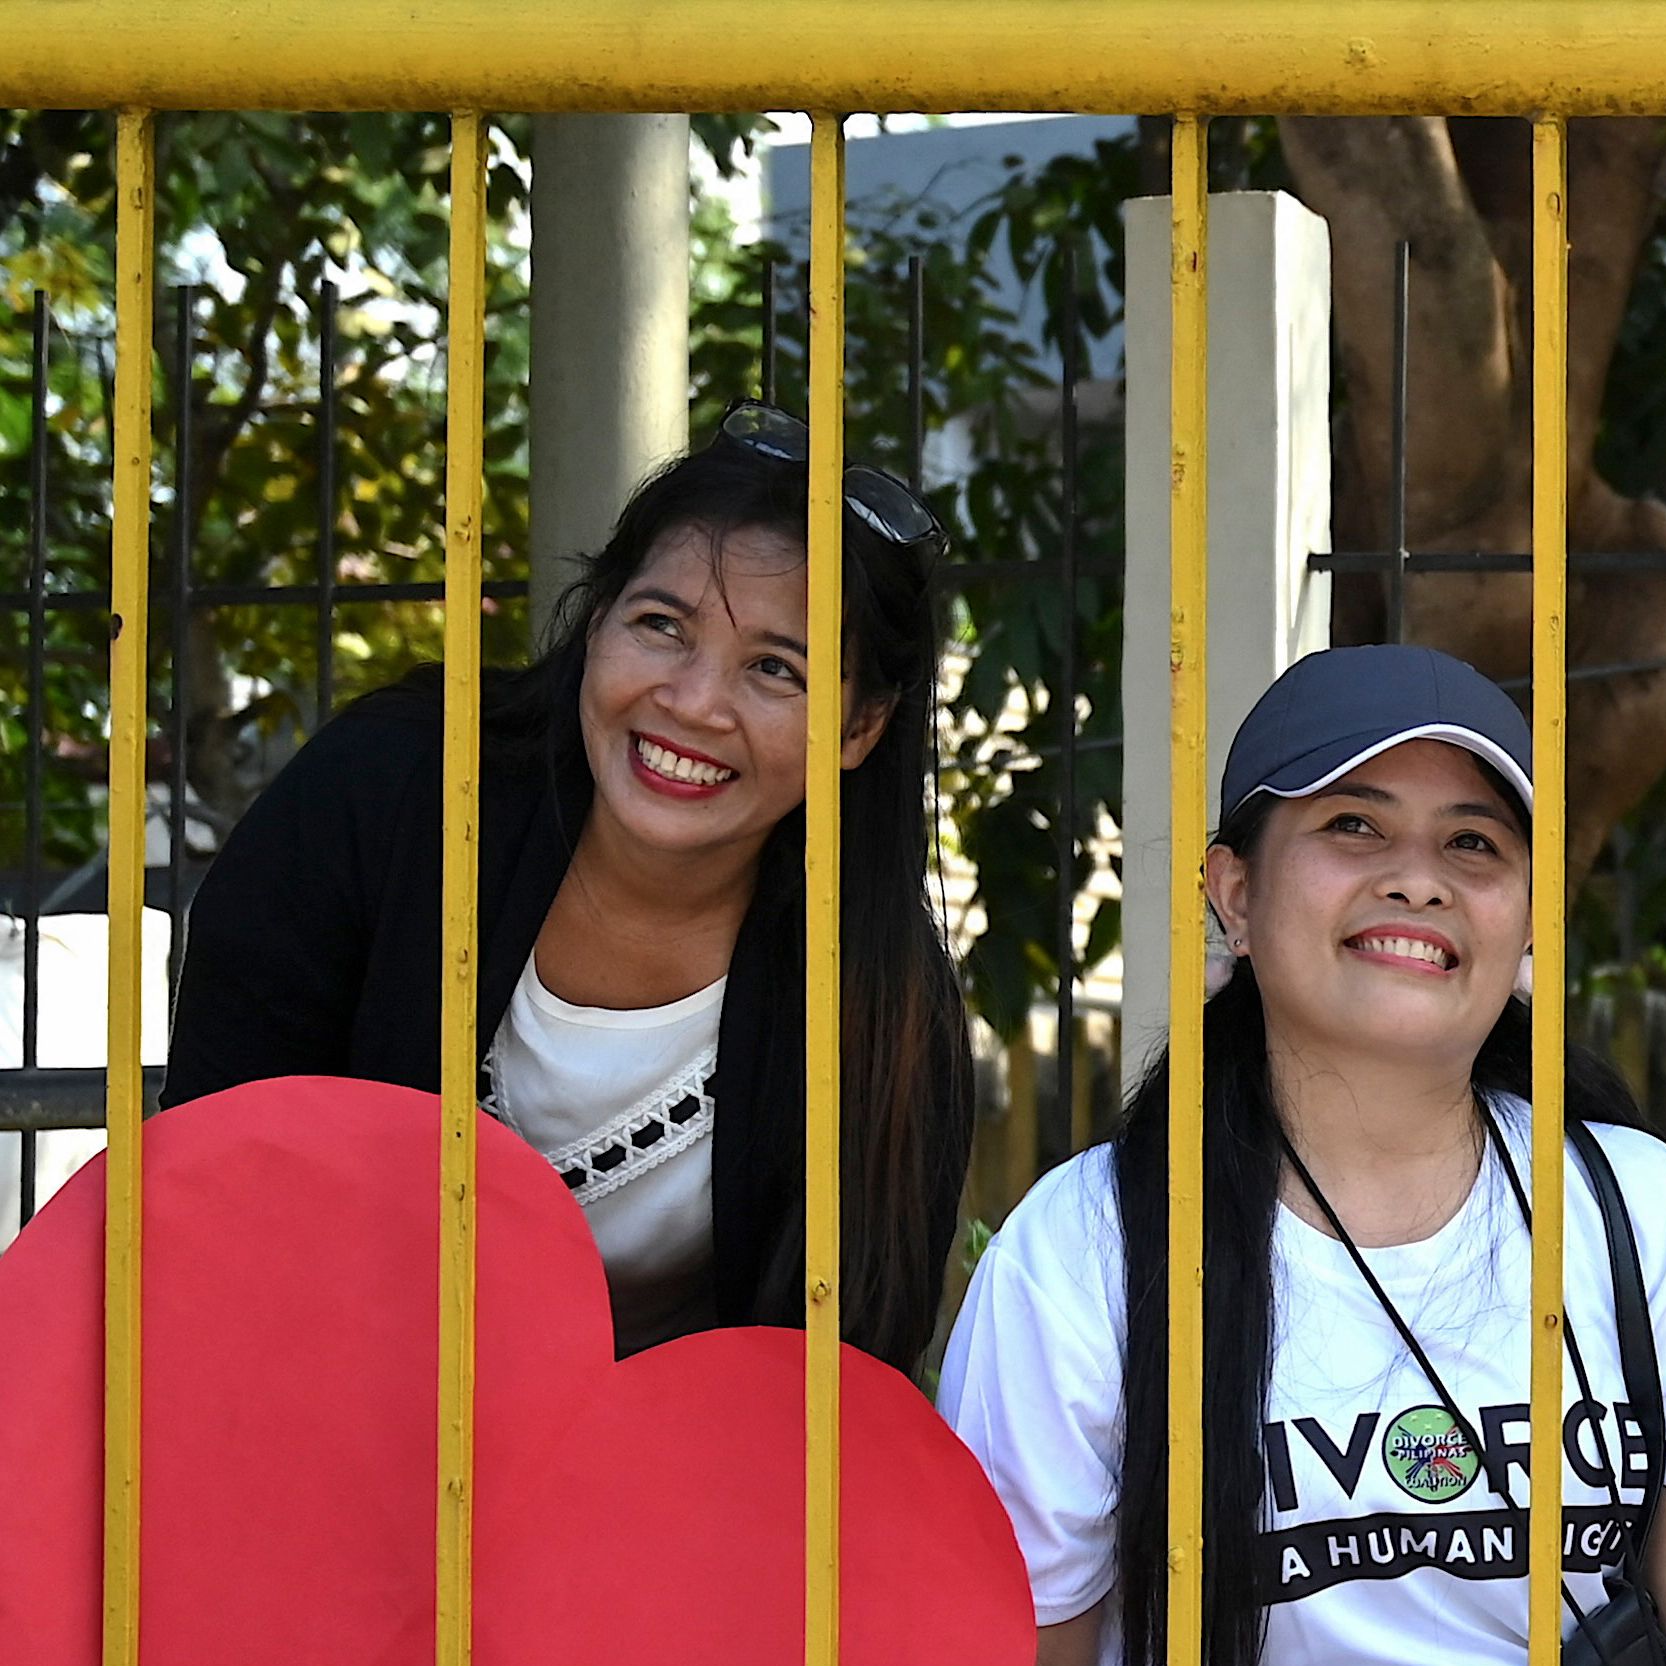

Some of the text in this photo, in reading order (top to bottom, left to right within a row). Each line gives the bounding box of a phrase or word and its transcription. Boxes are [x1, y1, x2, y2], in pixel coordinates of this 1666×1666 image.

[1392, 1433, 1467, 1448] DIVORCE
[1281, 1546, 1312, 1585] A
[1327, 1525, 1516, 1570] HUMAN
